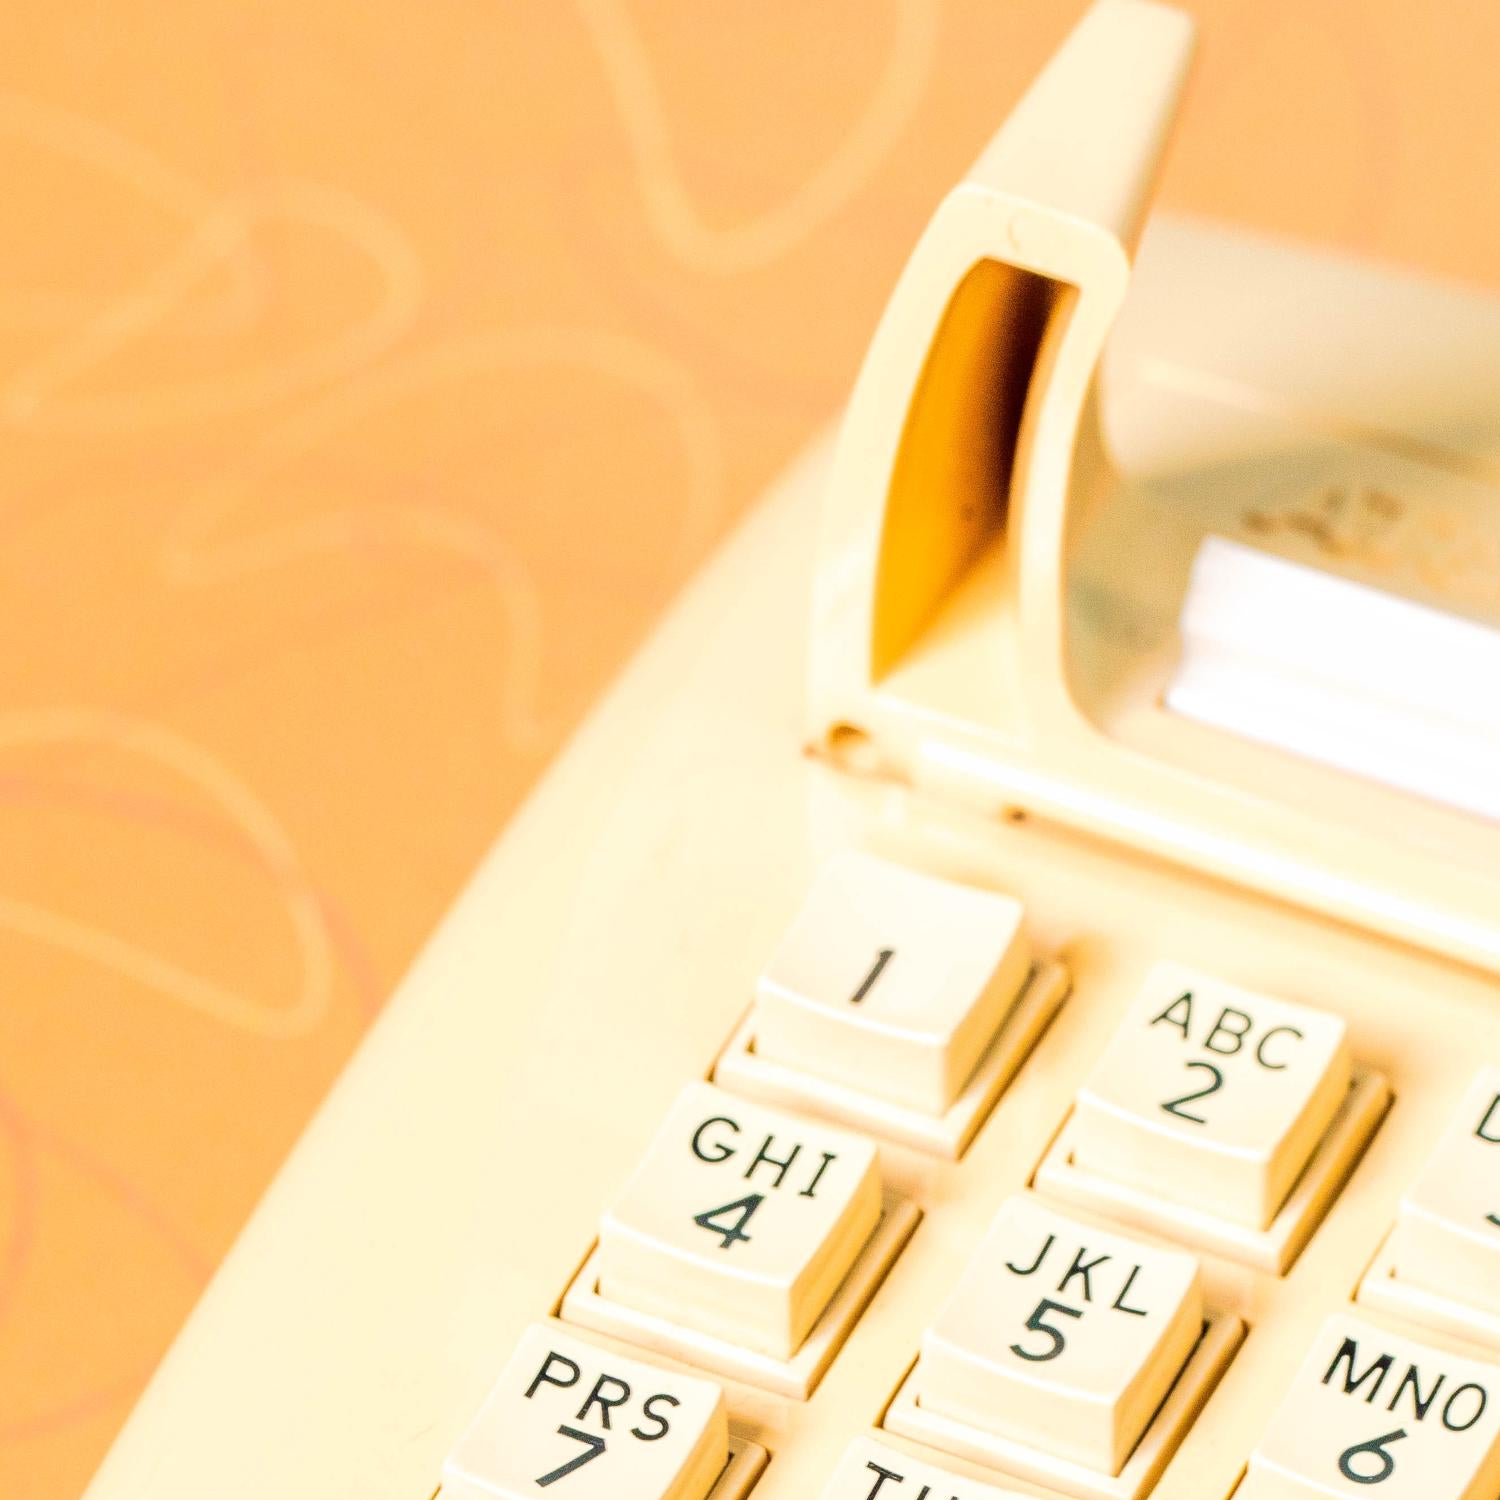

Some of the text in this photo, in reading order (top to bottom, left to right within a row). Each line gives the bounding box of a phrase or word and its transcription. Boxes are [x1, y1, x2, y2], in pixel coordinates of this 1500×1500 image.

[848, 946, 895, 1005] 1
[1149, 990, 1304, 1073] ABC
[1160, 1059, 1223, 1126] 2
[691, 1116, 838, 1199] GHI
[693, 1192, 766, 1249] 4
[1005, 1231, 1150, 1318] JKL
[1008, 1298, 1085, 1363] 5
[523, 1350, 681, 1441] PRS
[1321, 1335, 1488, 1434] MNO
[535, 1425, 608, 1490] 7
[1338, 1427, 1409, 1485] 6
